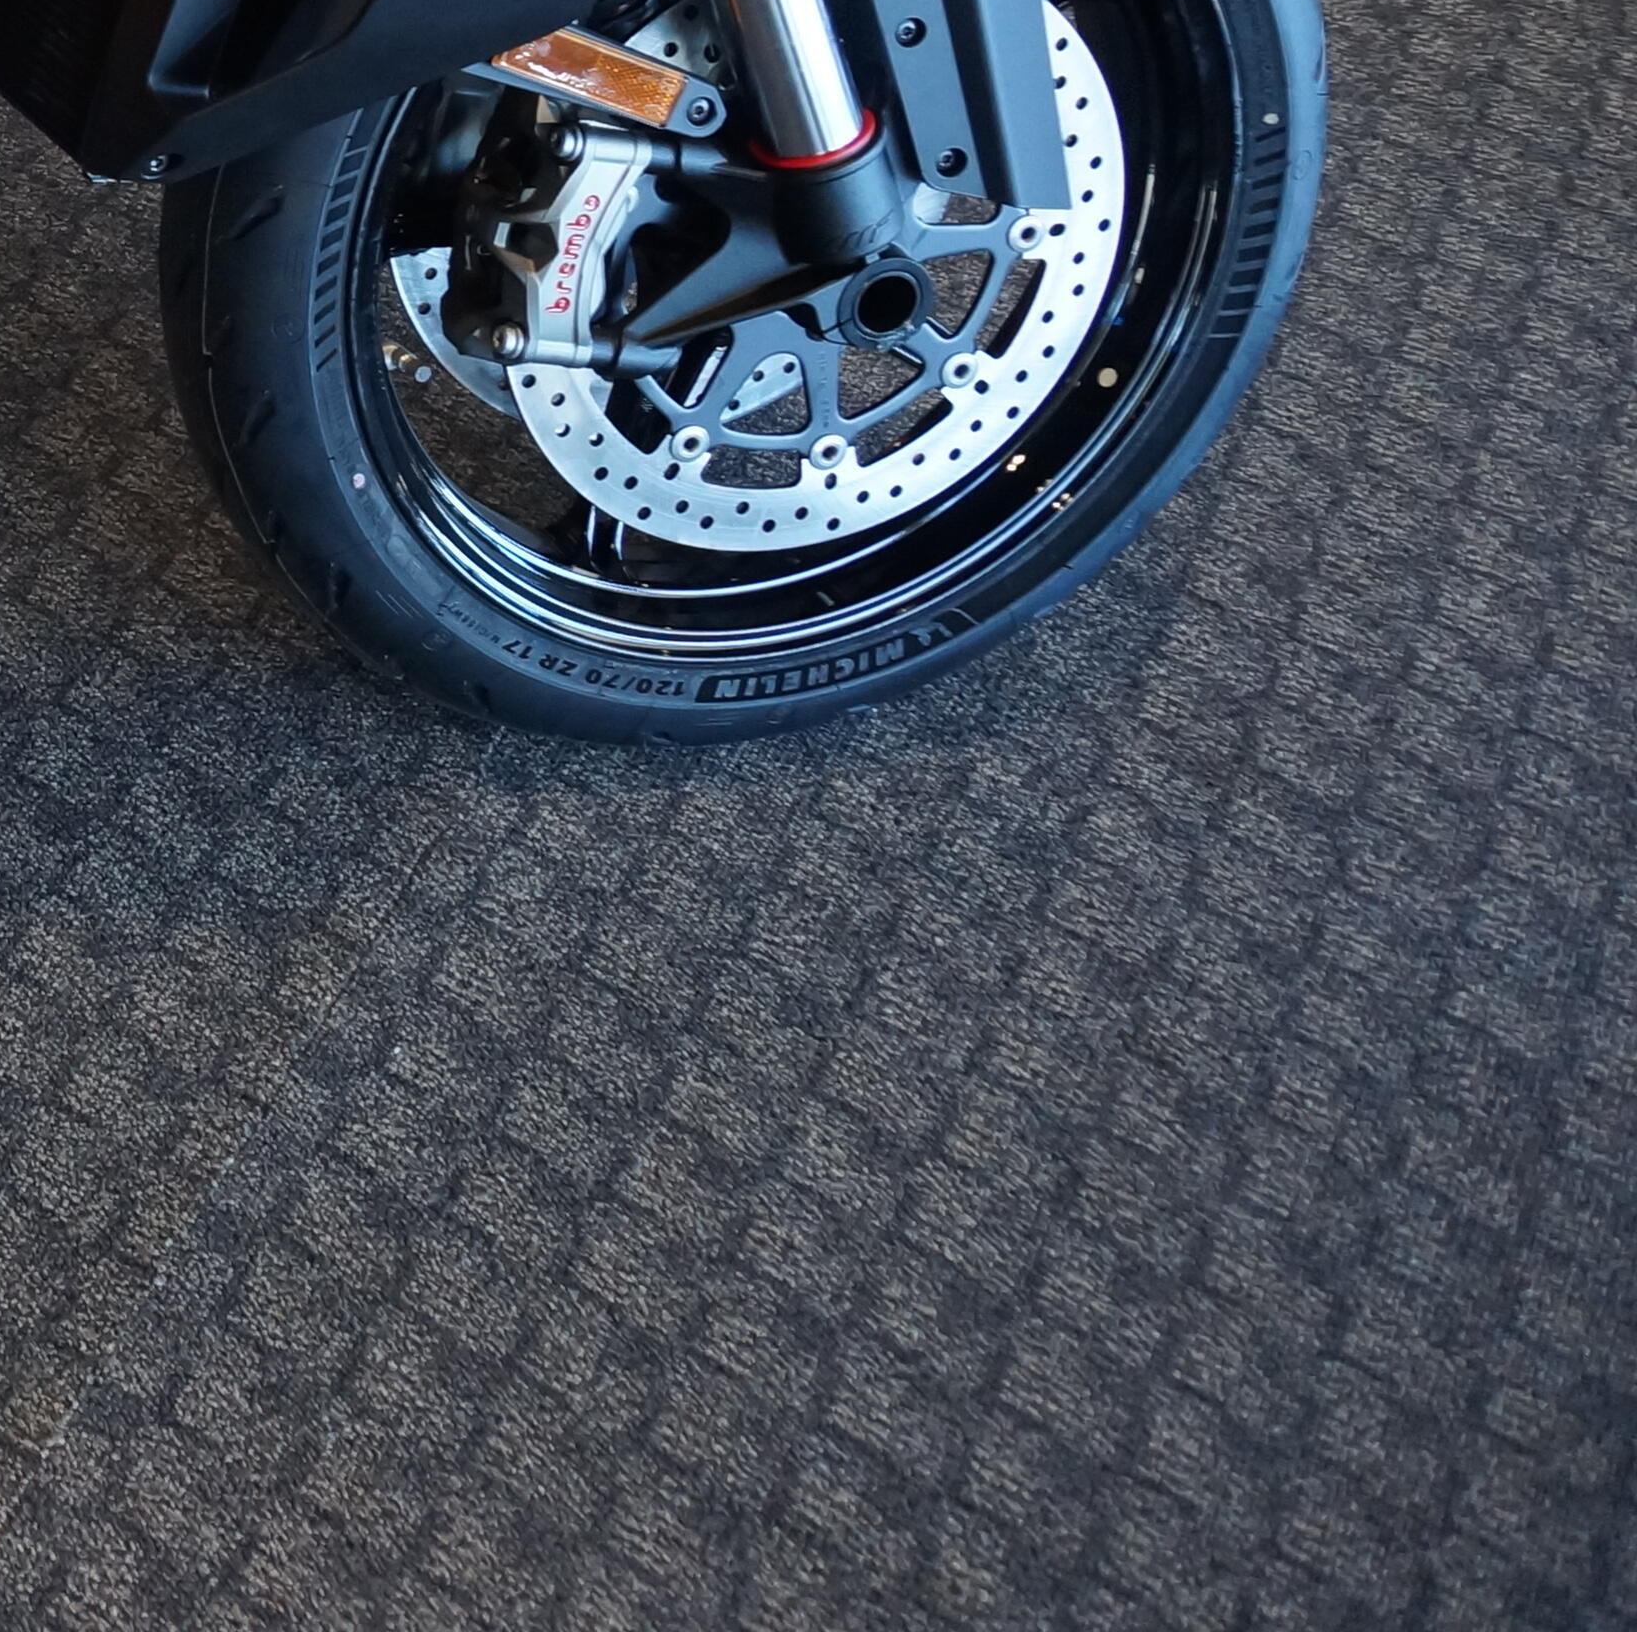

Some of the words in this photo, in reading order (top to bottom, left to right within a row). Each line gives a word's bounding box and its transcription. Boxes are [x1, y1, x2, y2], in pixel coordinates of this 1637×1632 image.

[544, 193, 601, 315] brembo
[501, 638, 533, 660] 17
[537, 654, 578, 677] ZR
[713, 637, 905, 699] MICHELIN
[584, 667, 685, 697] 120/70
